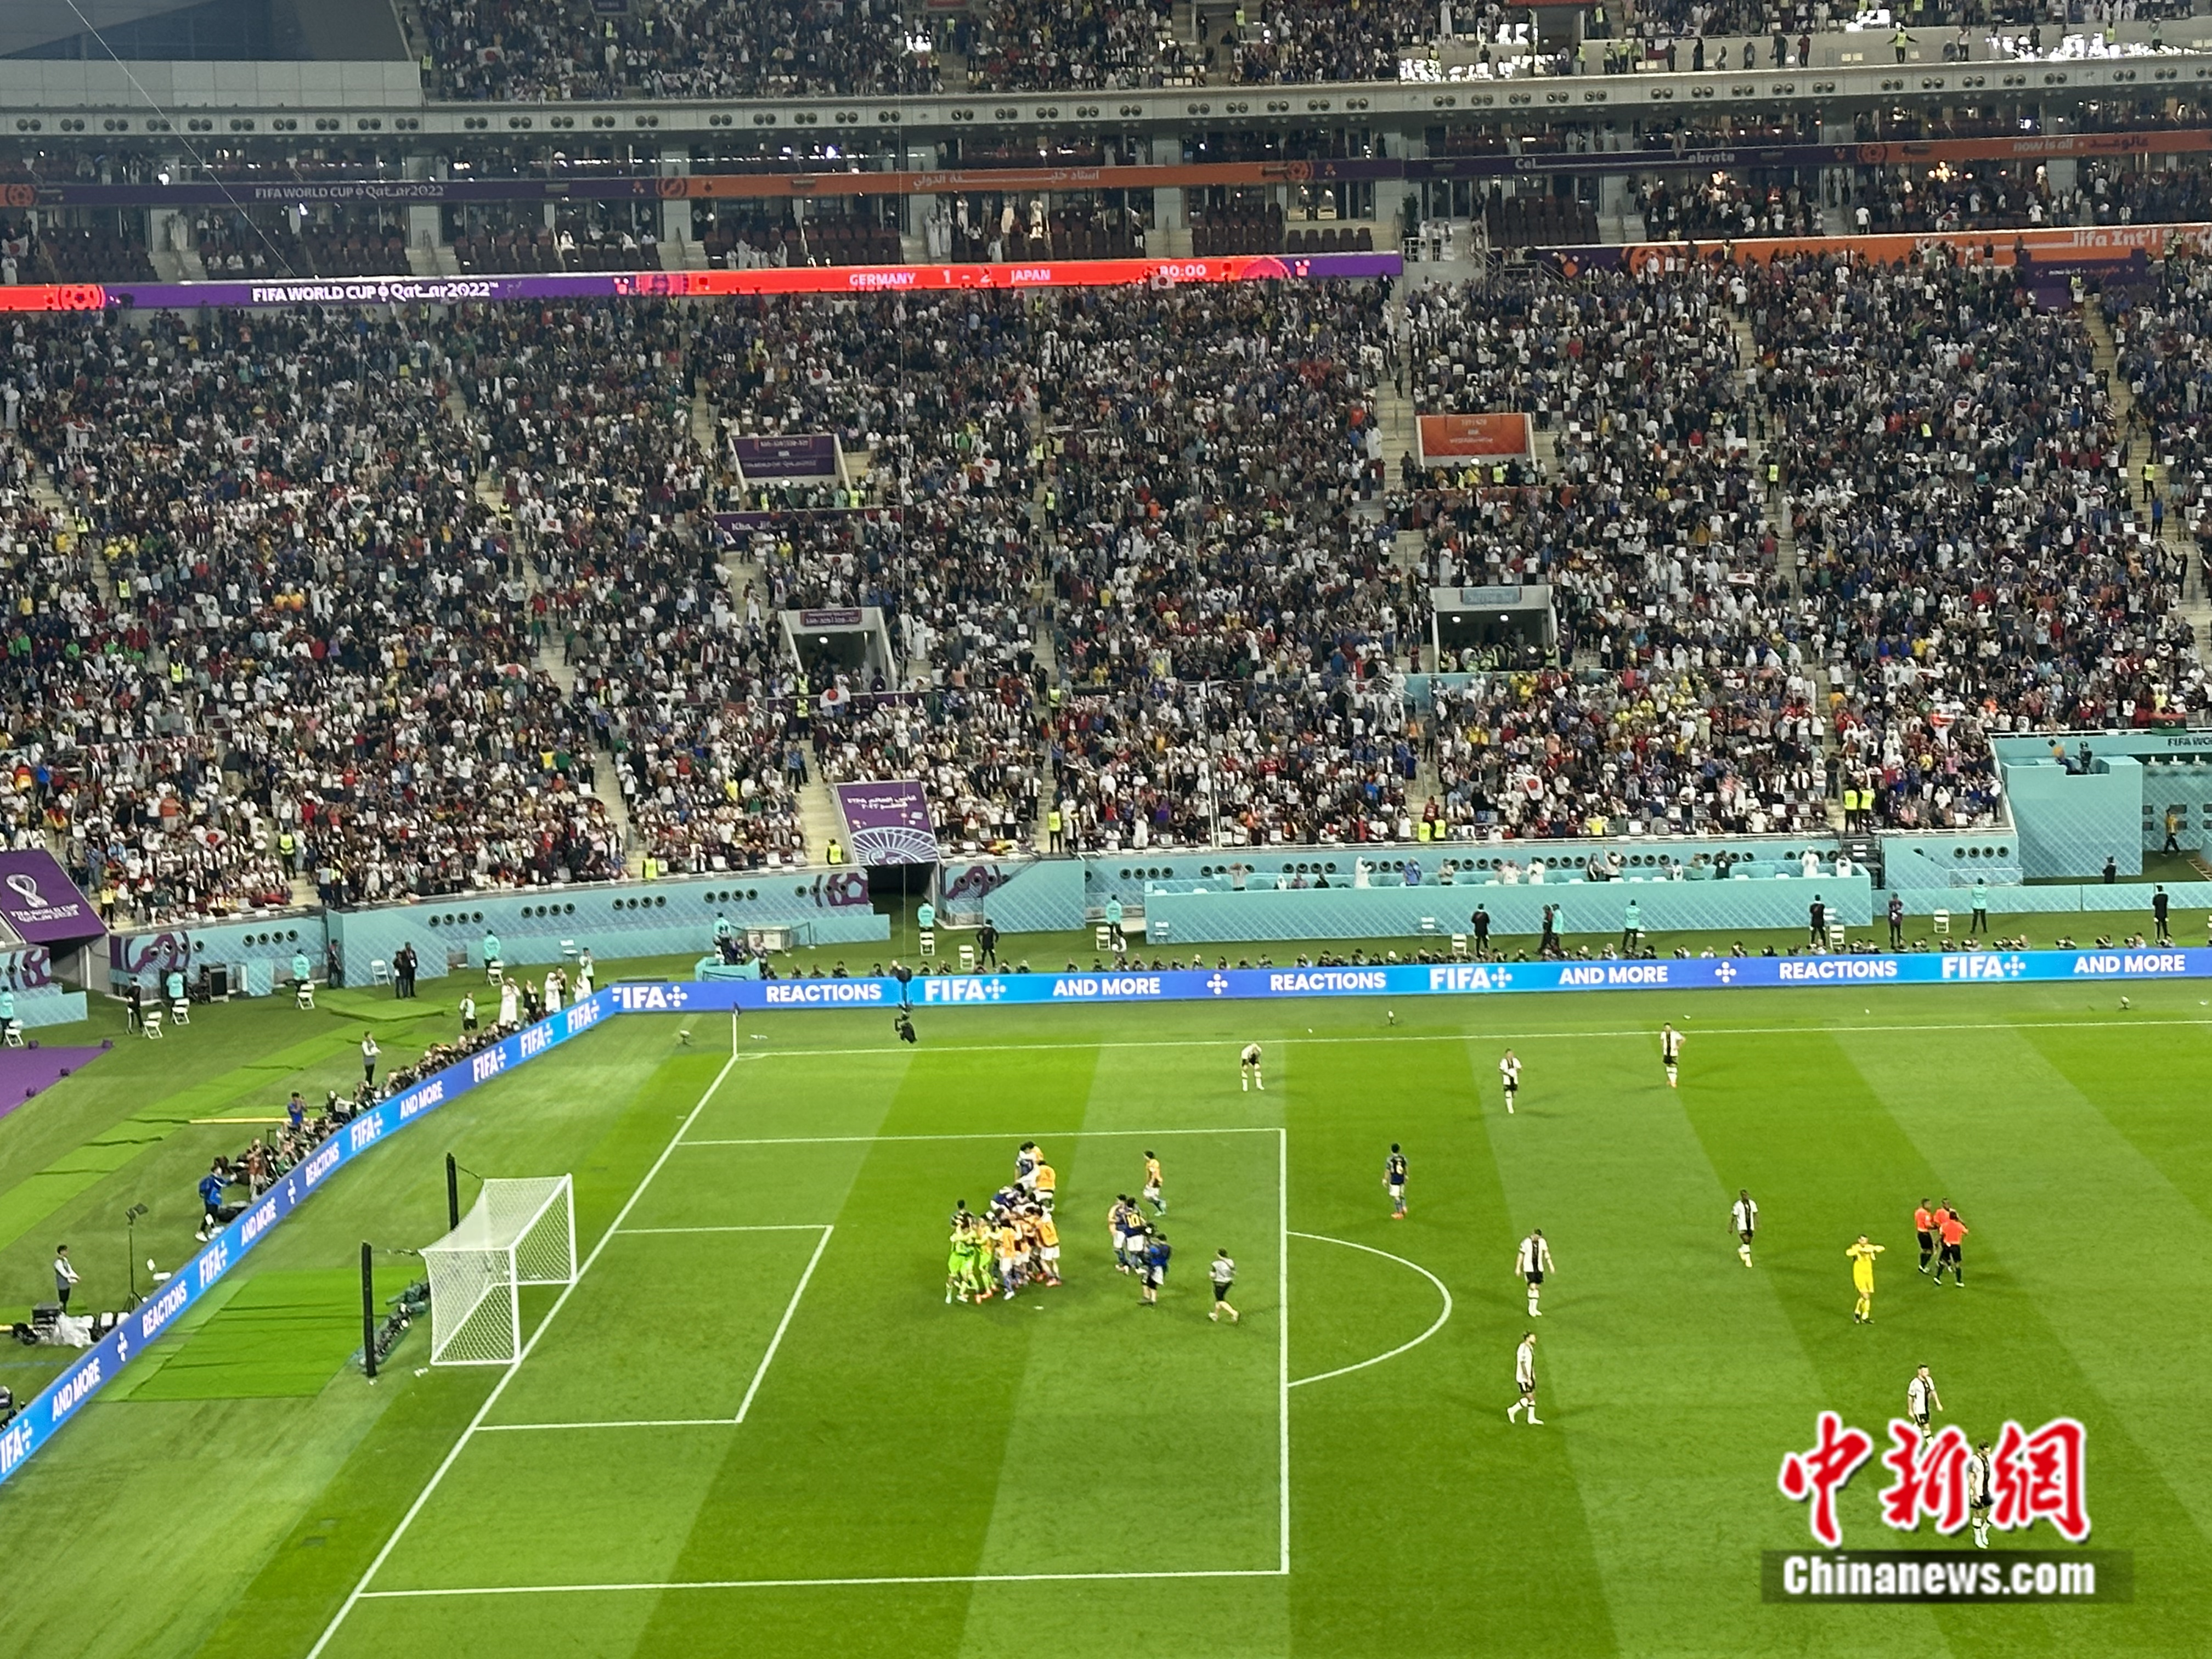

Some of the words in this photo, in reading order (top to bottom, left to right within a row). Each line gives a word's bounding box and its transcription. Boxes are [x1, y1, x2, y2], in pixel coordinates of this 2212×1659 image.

[2045, 138, 2056, 150] is
[2058, 138, 2073, 149] all
[255, 188, 284, 198] FIFA
[284, 187, 328, 198] WORLD
[330, 187, 354, 198] CUP
[849, 272, 916, 285] GERMANY
[943, 269, 950, 284] 1
[1011, 269, 1051, 284] JAPAN
[253, 286, 289, 302] FIFA
[289, 286, 343, 301] WORLD
[345, 285, 379, 300] CUP
[1779, 960, 1898, 980] REACTIONS
[2074, 956, 2121, 974] AND
[2125, 954, 2186, 973] MORE
[1270, 972, 1386, 991] REACTIONS
[1559, 968, 1605, 985] AND
[1609, 966, 1668, 984] MORE
[766, 983, 882, 1002] REACTIONS
[1053, 979, 1098, 996] AND
[1102, 977, 1161, 995] MORE
[400, 1096, 418, 1120] AND
[419, 1081, 444, 1109] MORE
[306, 1142, 339, 1187] REACTIONS
[241, 1216, 256, 1246] AND
[256, 1197, 276, 1232] MORE
[142, 1280, 187, 1338] REACTIONS
[53, 1388, 72, 1421] AND
[74, 1357, 100, 1401] MORE
